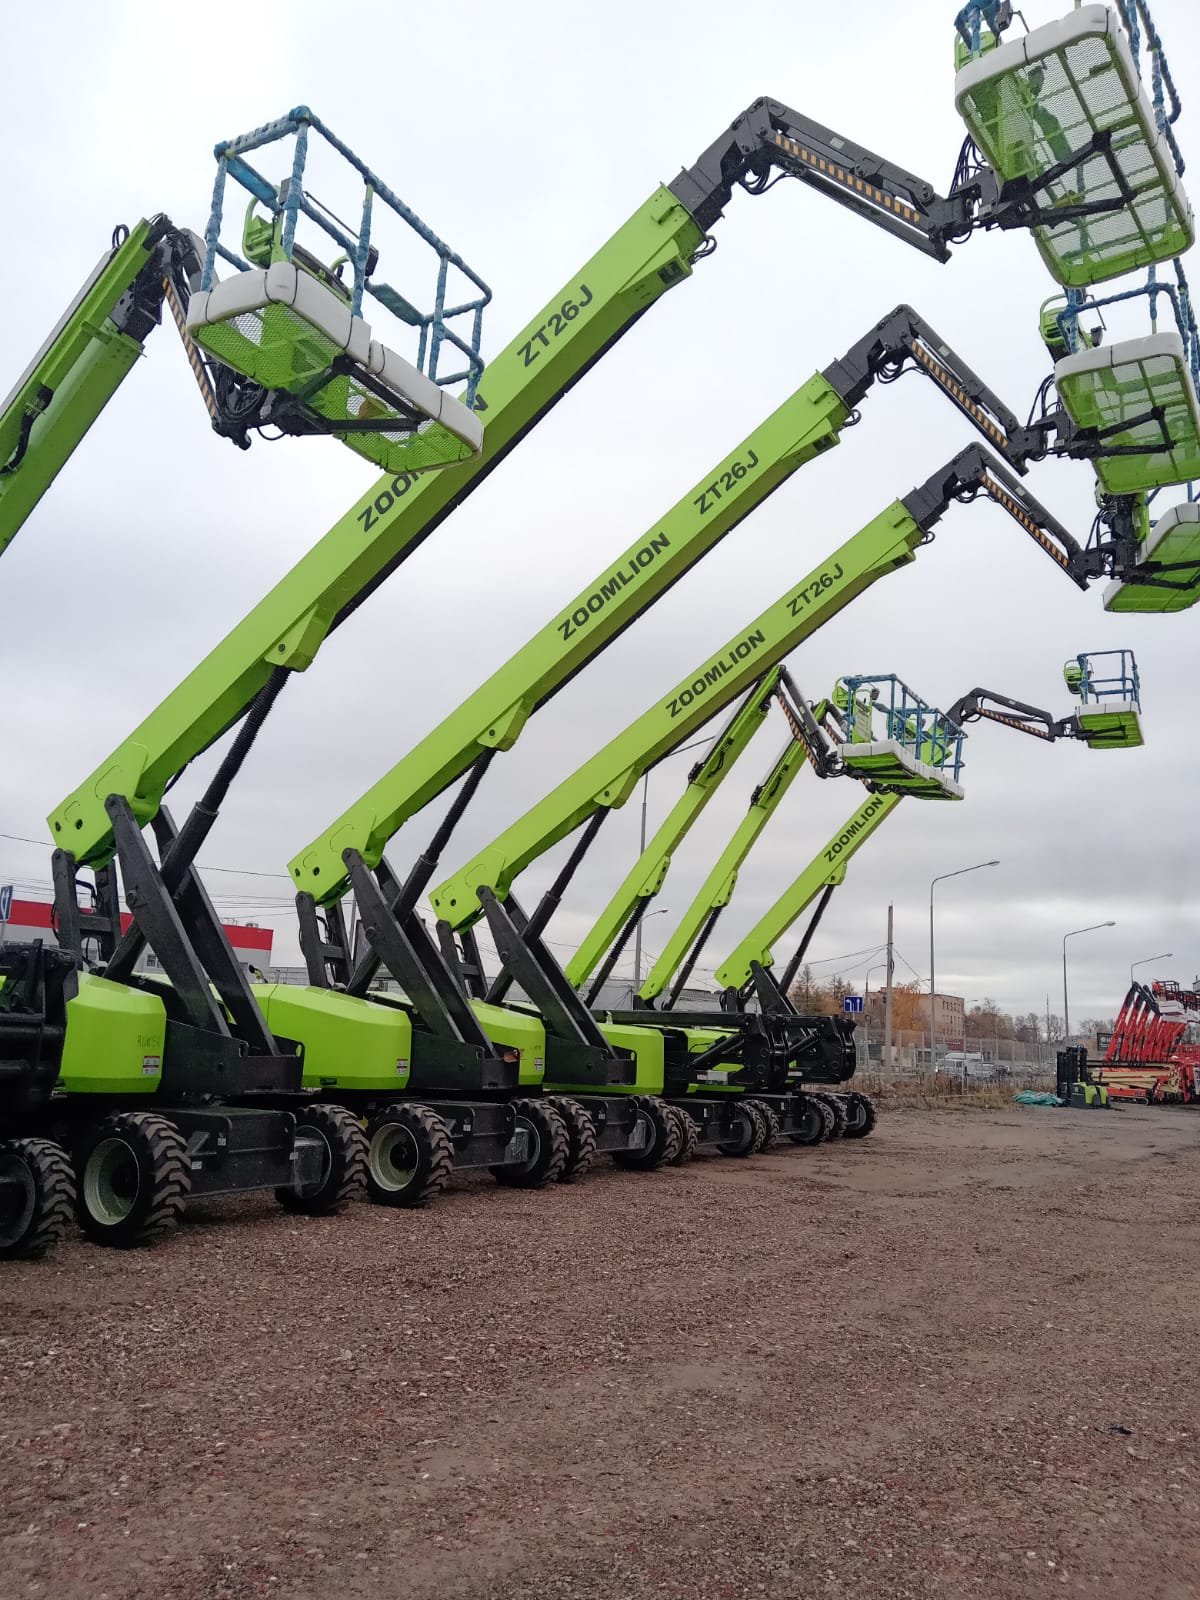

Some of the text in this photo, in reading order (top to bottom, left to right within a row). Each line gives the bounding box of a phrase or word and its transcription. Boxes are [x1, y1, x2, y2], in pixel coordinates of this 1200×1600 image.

[517, 284, 593, 367] ZT26J
[557, 449, 759, 641] ZOOMLION ZT26J
[665, 563, 844, 718] ZOOMLION ZT26J
[823, 797, 884, 862] ZOOMLION
